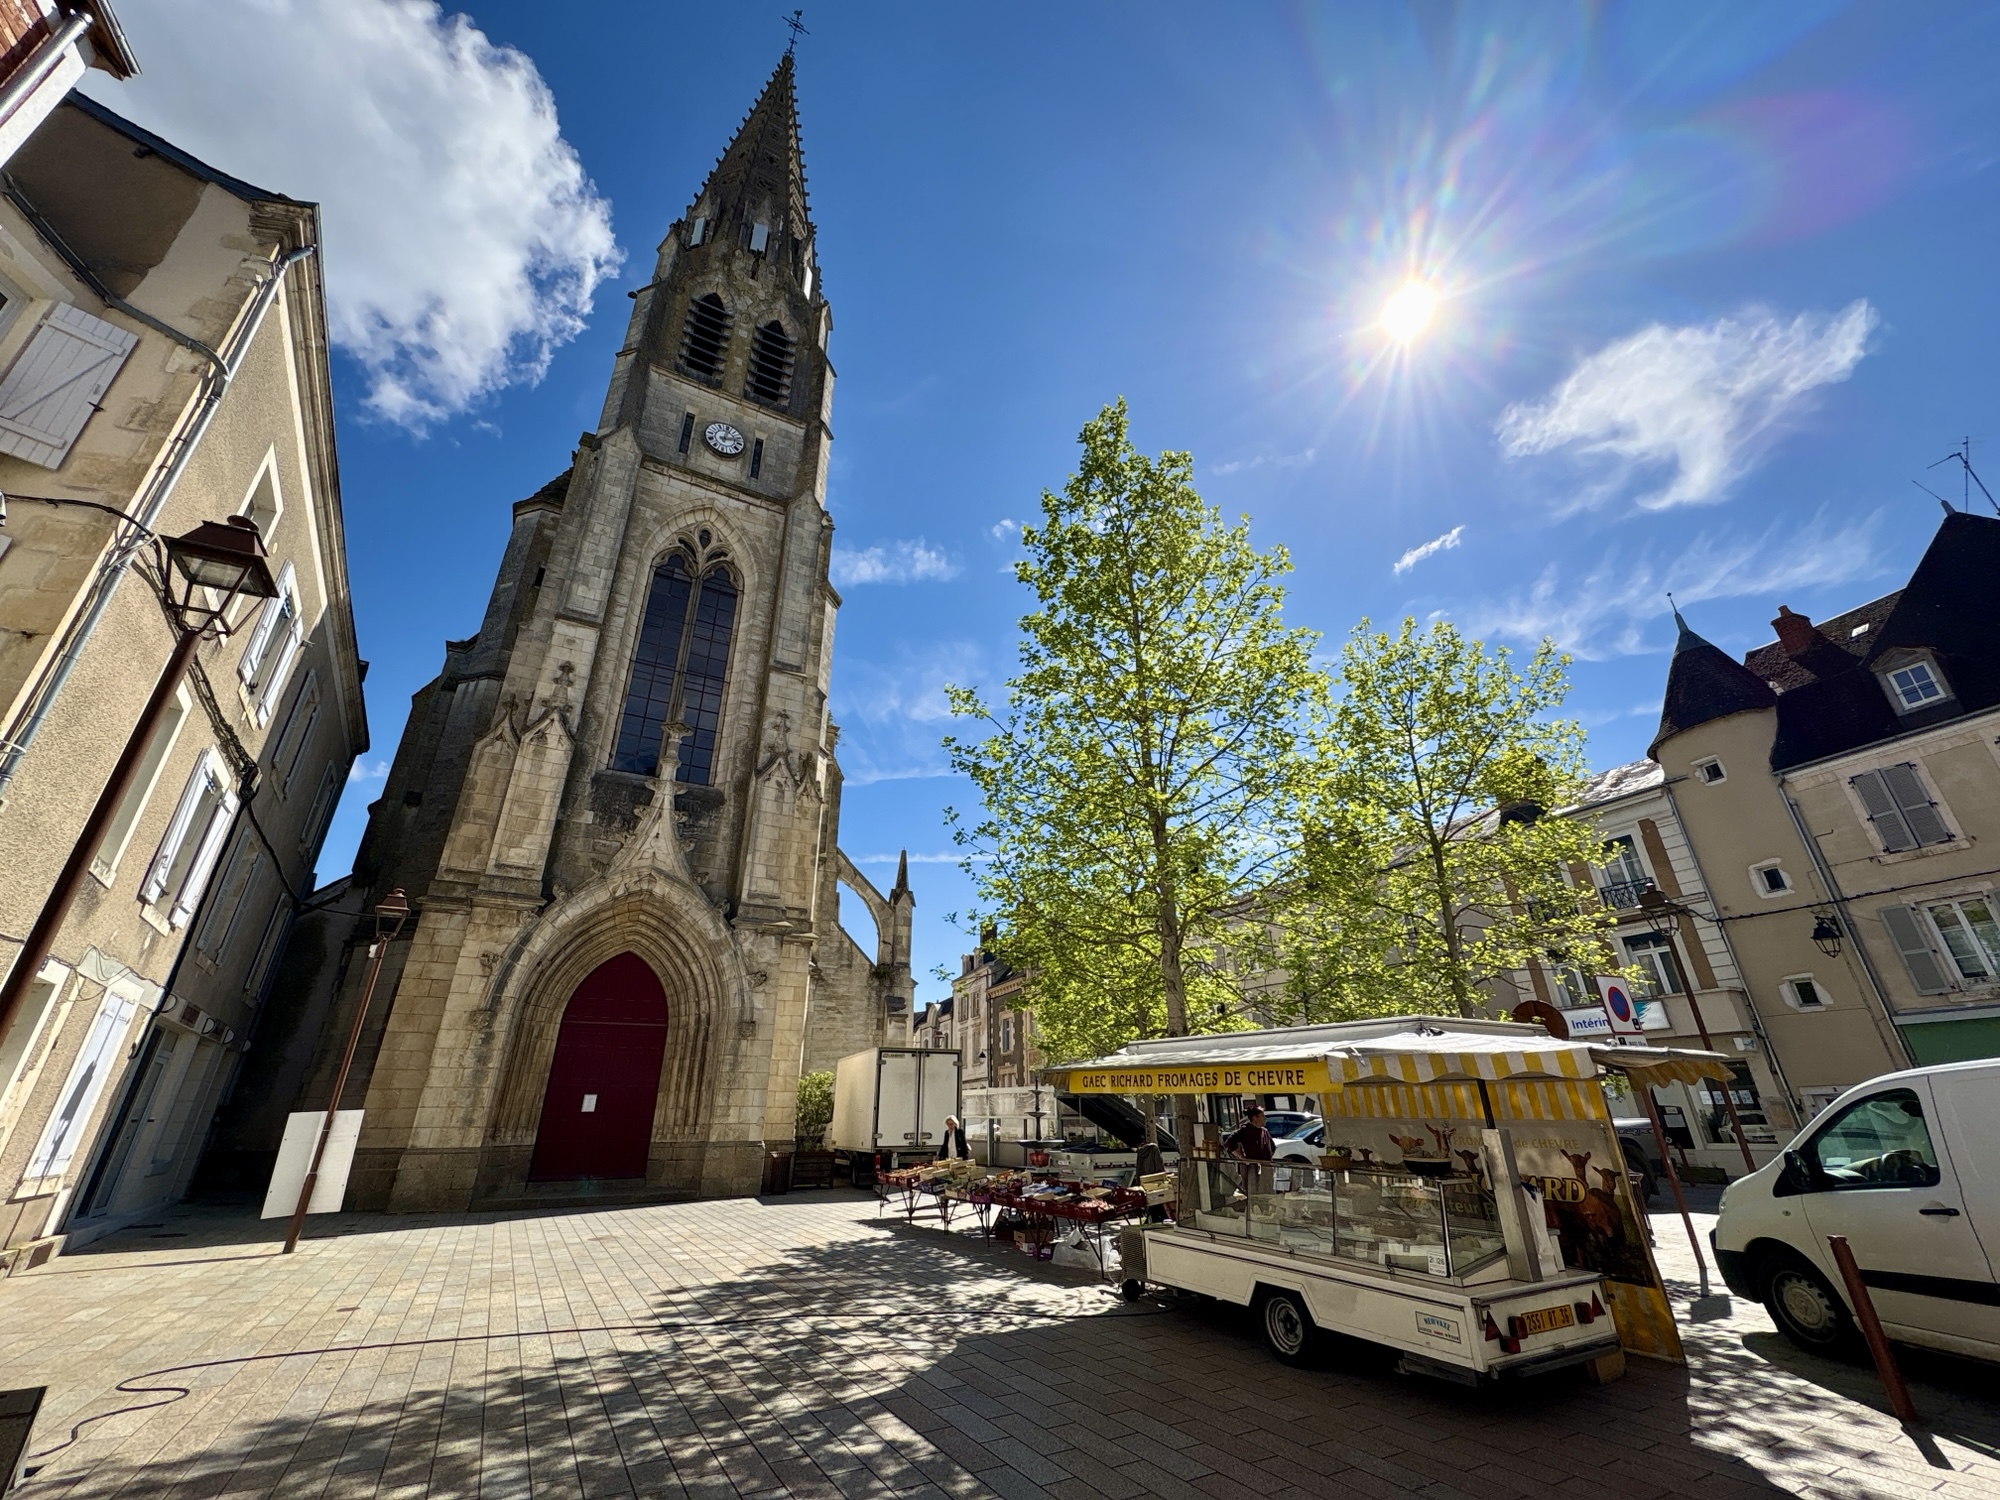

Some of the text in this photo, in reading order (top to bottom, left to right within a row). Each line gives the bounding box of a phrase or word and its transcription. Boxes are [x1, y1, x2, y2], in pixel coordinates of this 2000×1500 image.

[1082, 1069, 1305, 1088] GAEC RICHARD FROMAGES DE CHEVRE
[1514, 1138, 1528, 1148] de
[1429, 1255, 1445, 1266] 226
